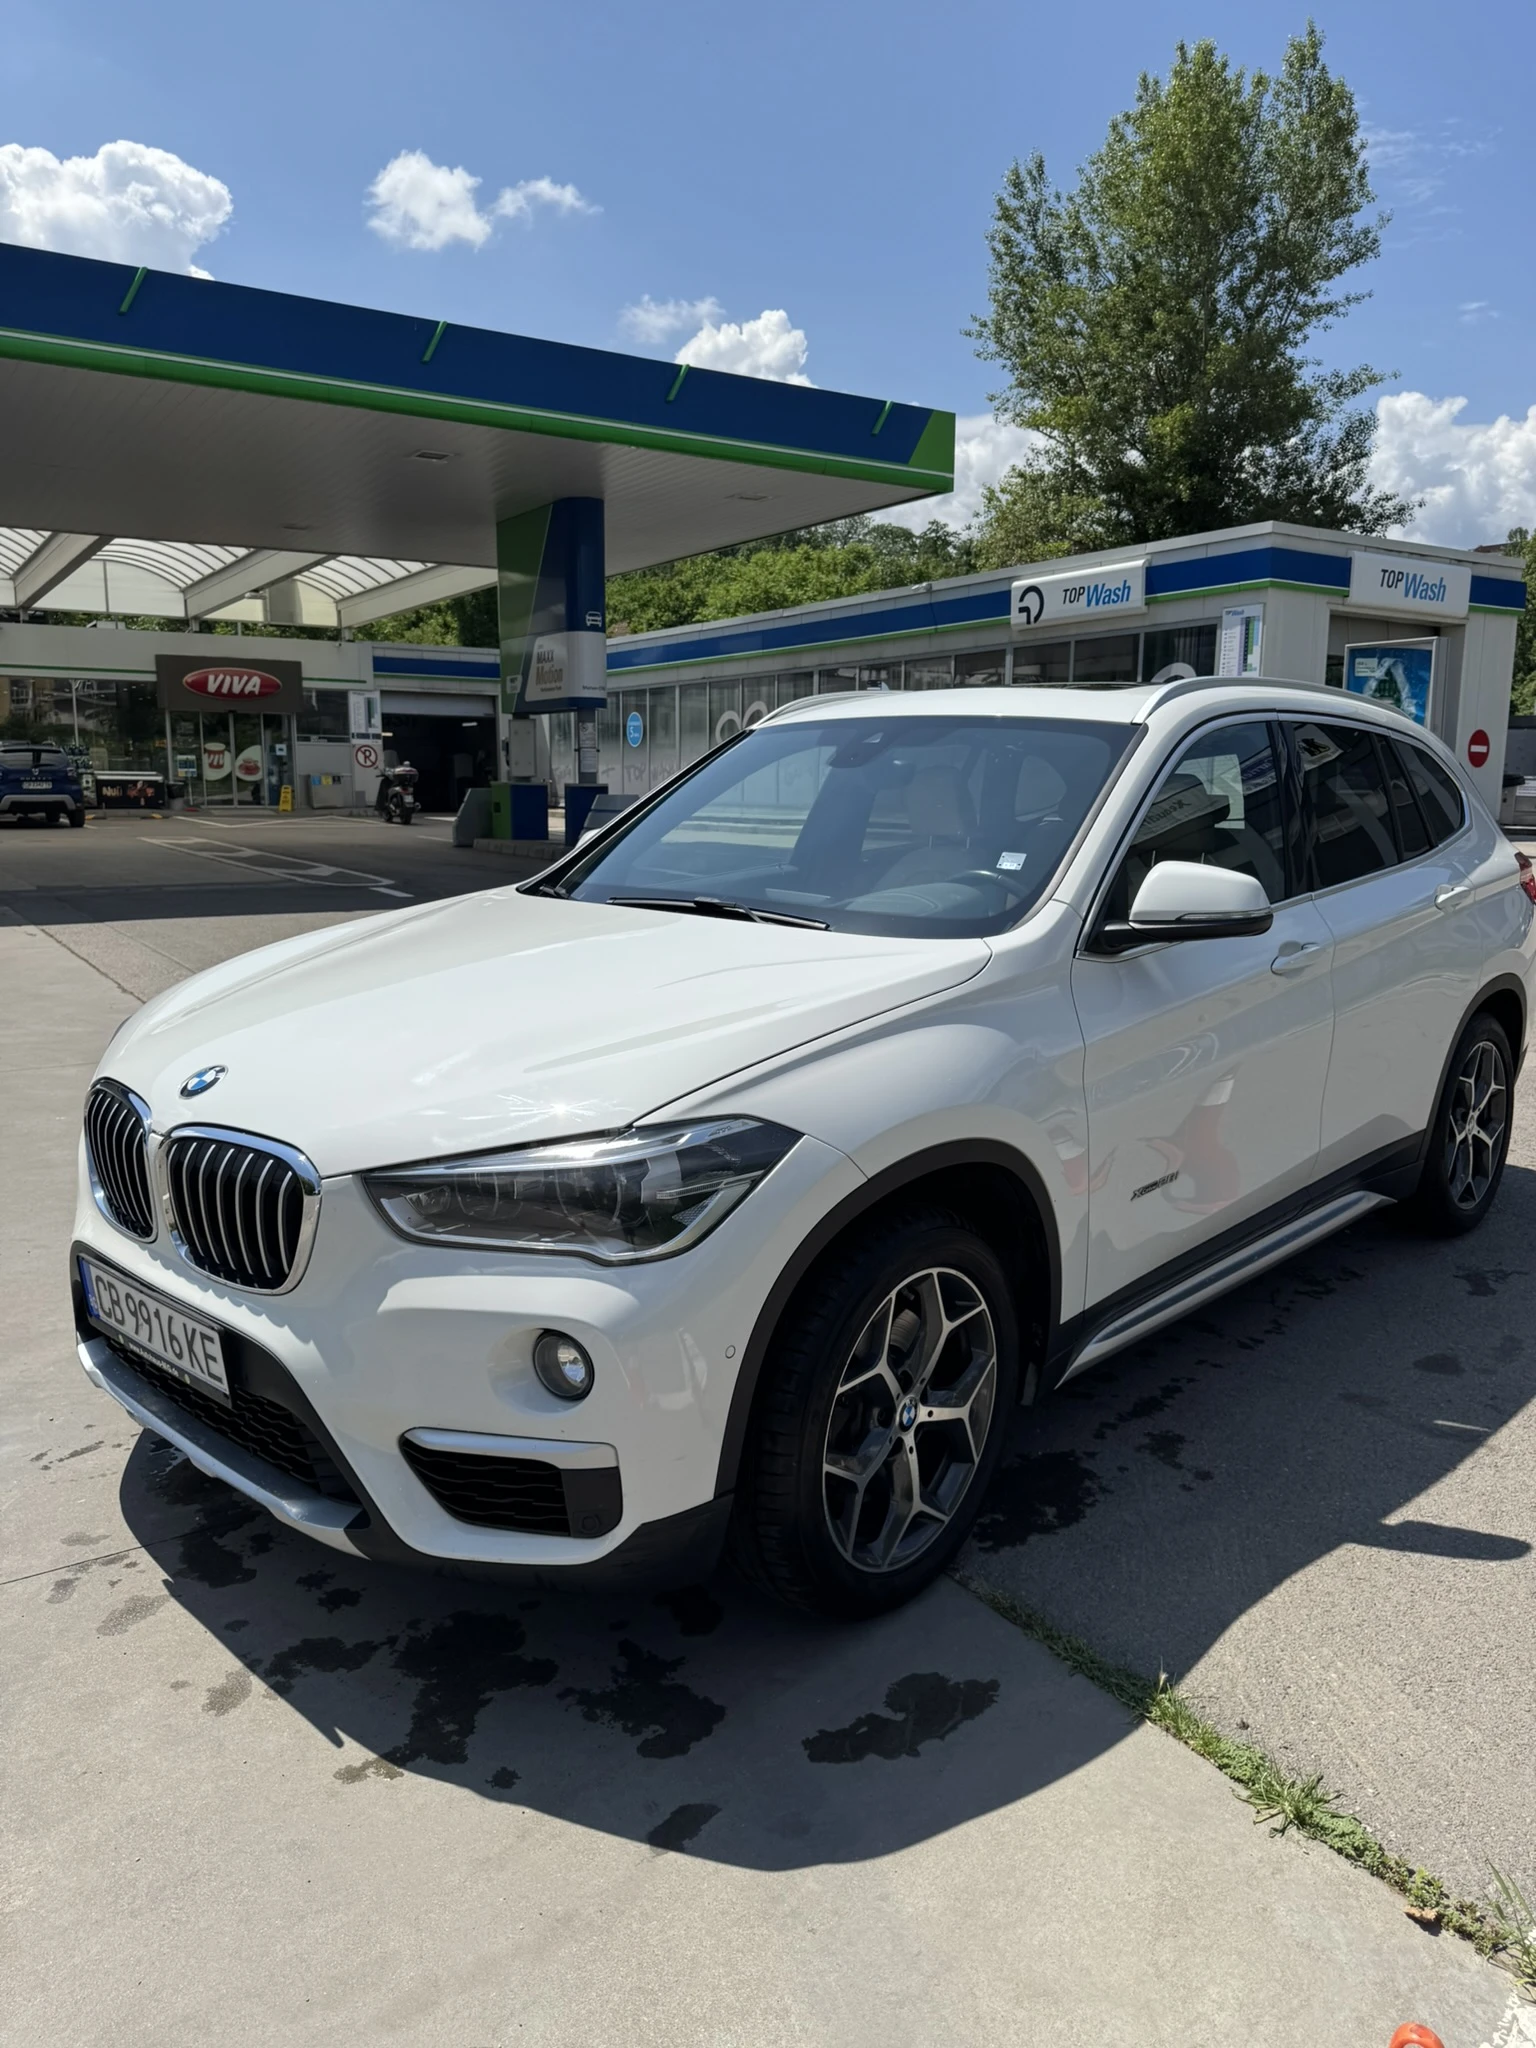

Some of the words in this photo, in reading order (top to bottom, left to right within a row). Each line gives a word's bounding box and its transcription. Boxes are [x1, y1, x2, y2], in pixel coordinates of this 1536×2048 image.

[1062, 580, 1131, 608] TOPWash
[1380, 568, 1447, 602] TOPWash
[207, 674, 261, 695] VIVA
